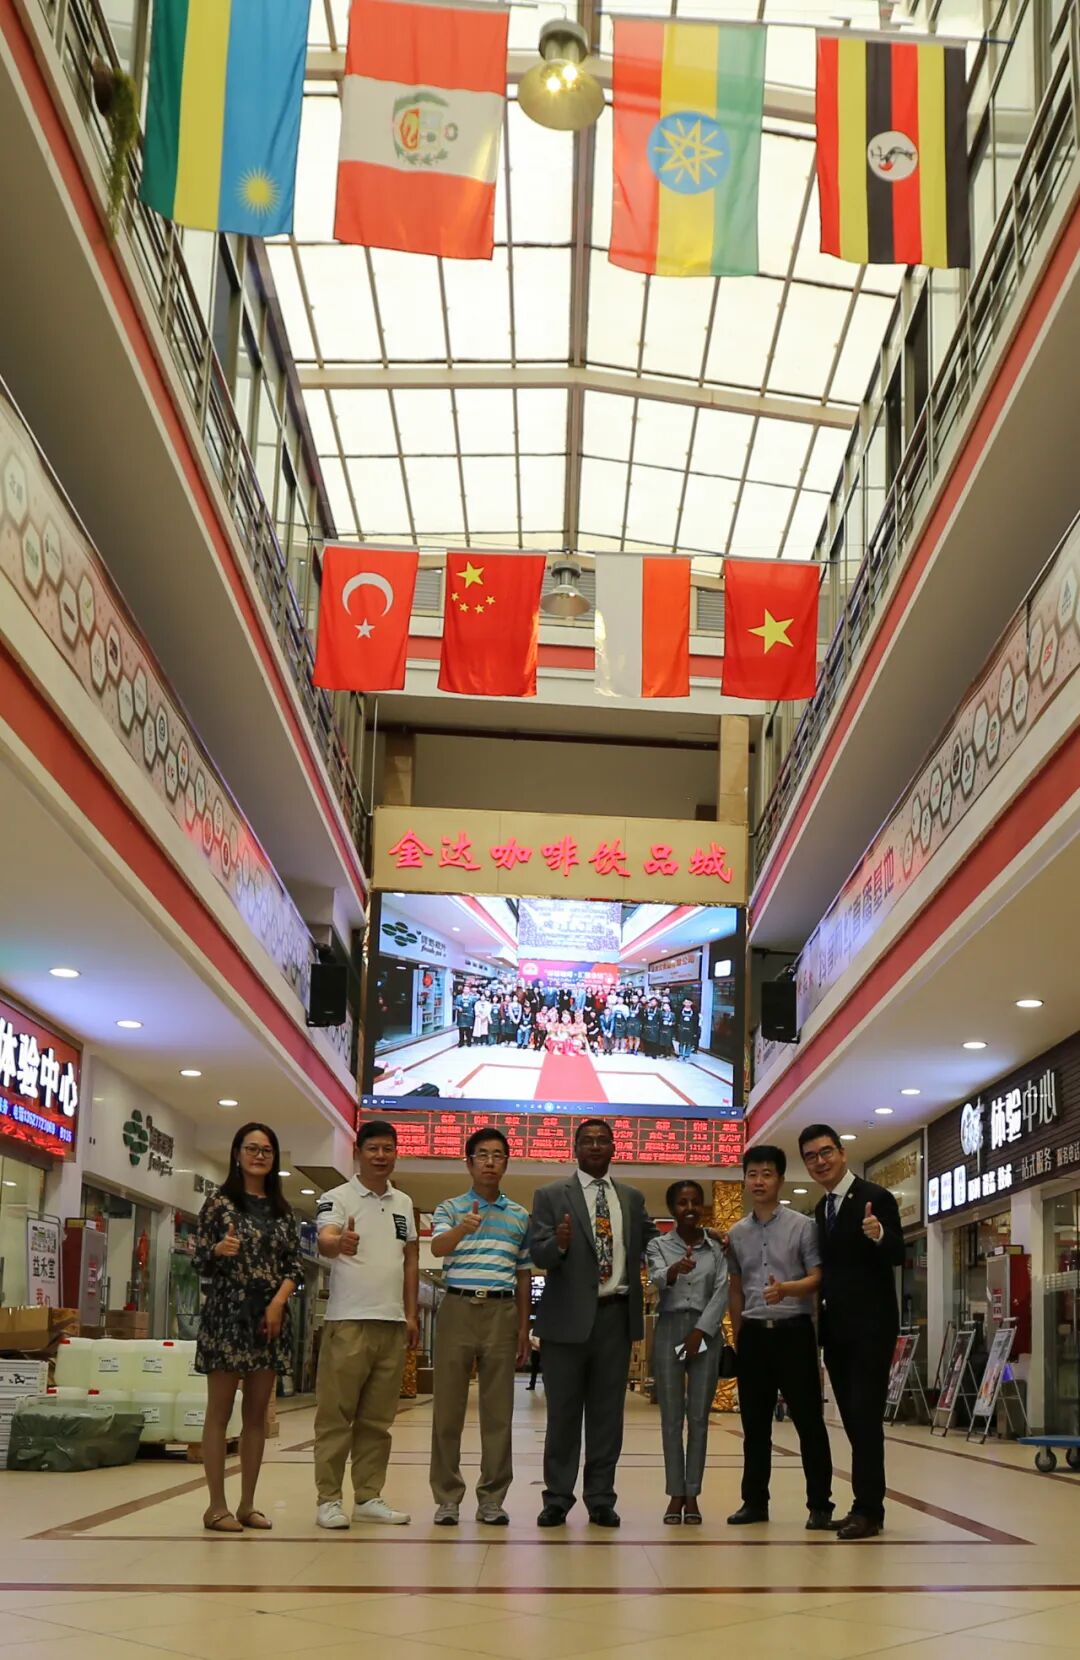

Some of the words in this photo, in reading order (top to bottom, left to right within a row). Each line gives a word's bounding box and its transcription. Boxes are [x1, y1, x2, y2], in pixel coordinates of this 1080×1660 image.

[388, 828, 733, 883] 金达咖啡饮品城
[990, 1069, 1058, 1150] 体验中心
[32, 1255, 56, 1279] 益禾堂
